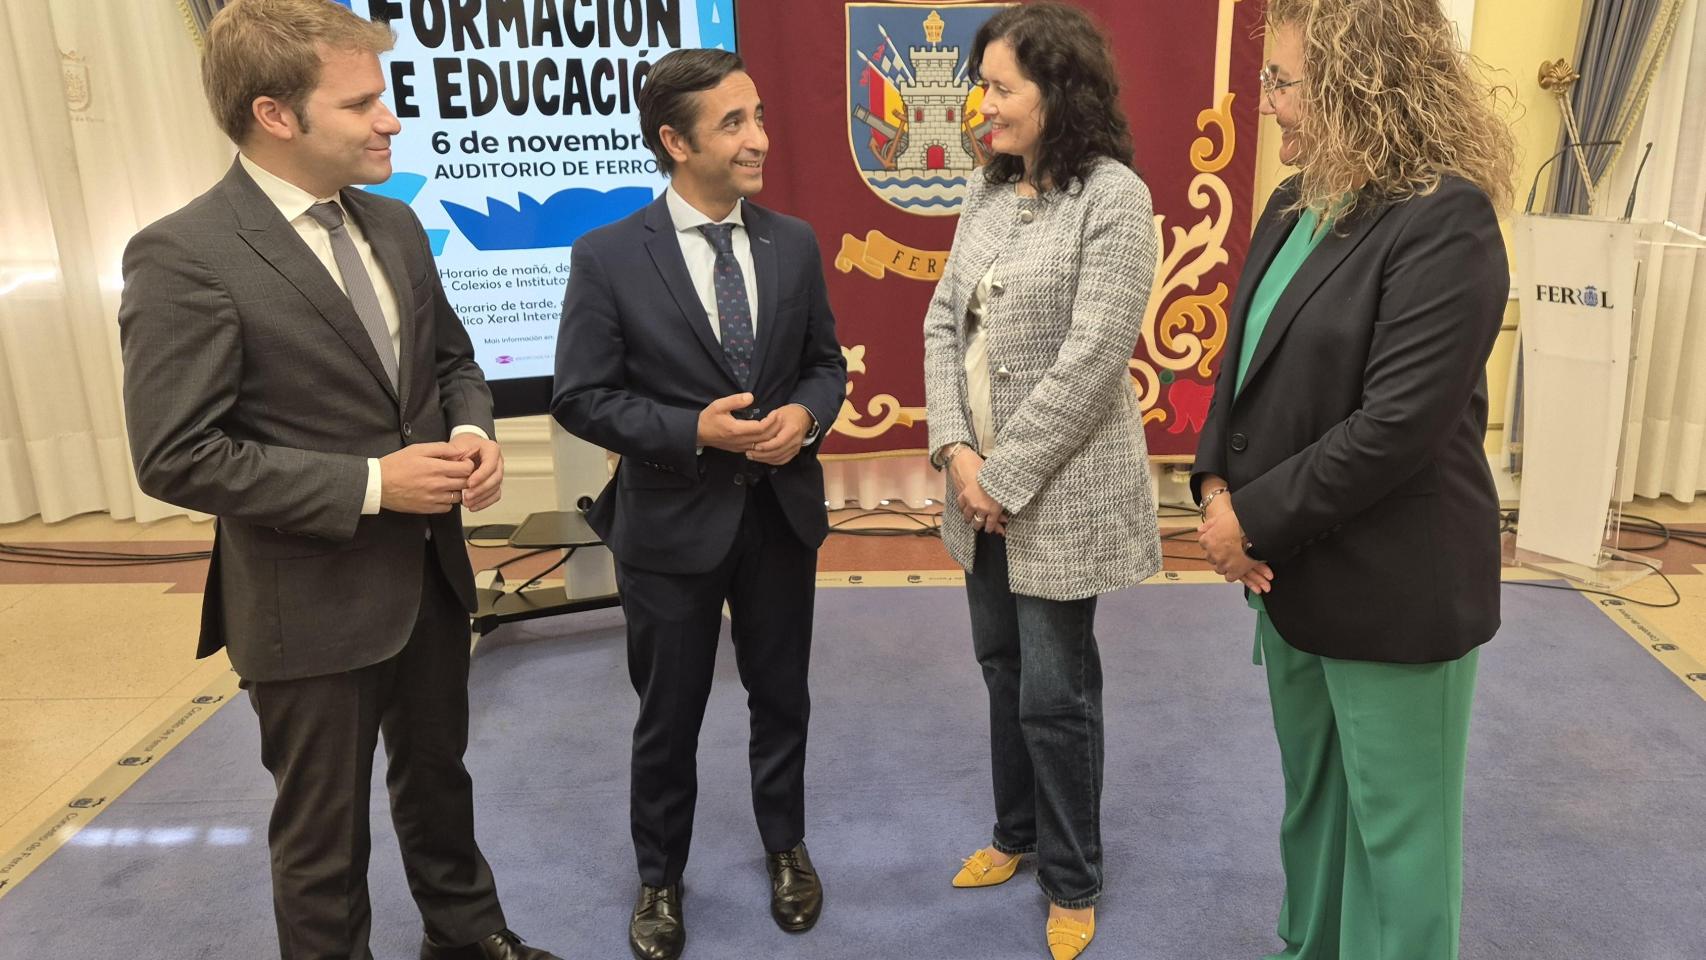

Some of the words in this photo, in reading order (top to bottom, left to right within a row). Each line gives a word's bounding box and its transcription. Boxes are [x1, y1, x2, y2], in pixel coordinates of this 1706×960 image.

[390, 61, 420, 118] E
[432, 131, 451, 154] 6
[460, 130, 499, 154] de
[508, 128, 651, 152] novembr
[435, 162, 556, 179] AUDITORIO
[563, 161, 589, 175] DE
[892, 249, 948, 273] FER
[440, 267, 488, 279] Horario
[493, 266, 508, 276] de
[556, 262, 570, 273] de
[452, 279, 502, 291] Colexios
[506, 280, 512, 288] e
[501, 300, 516, 311] de
[487, 312, 519, 324] Xeral
